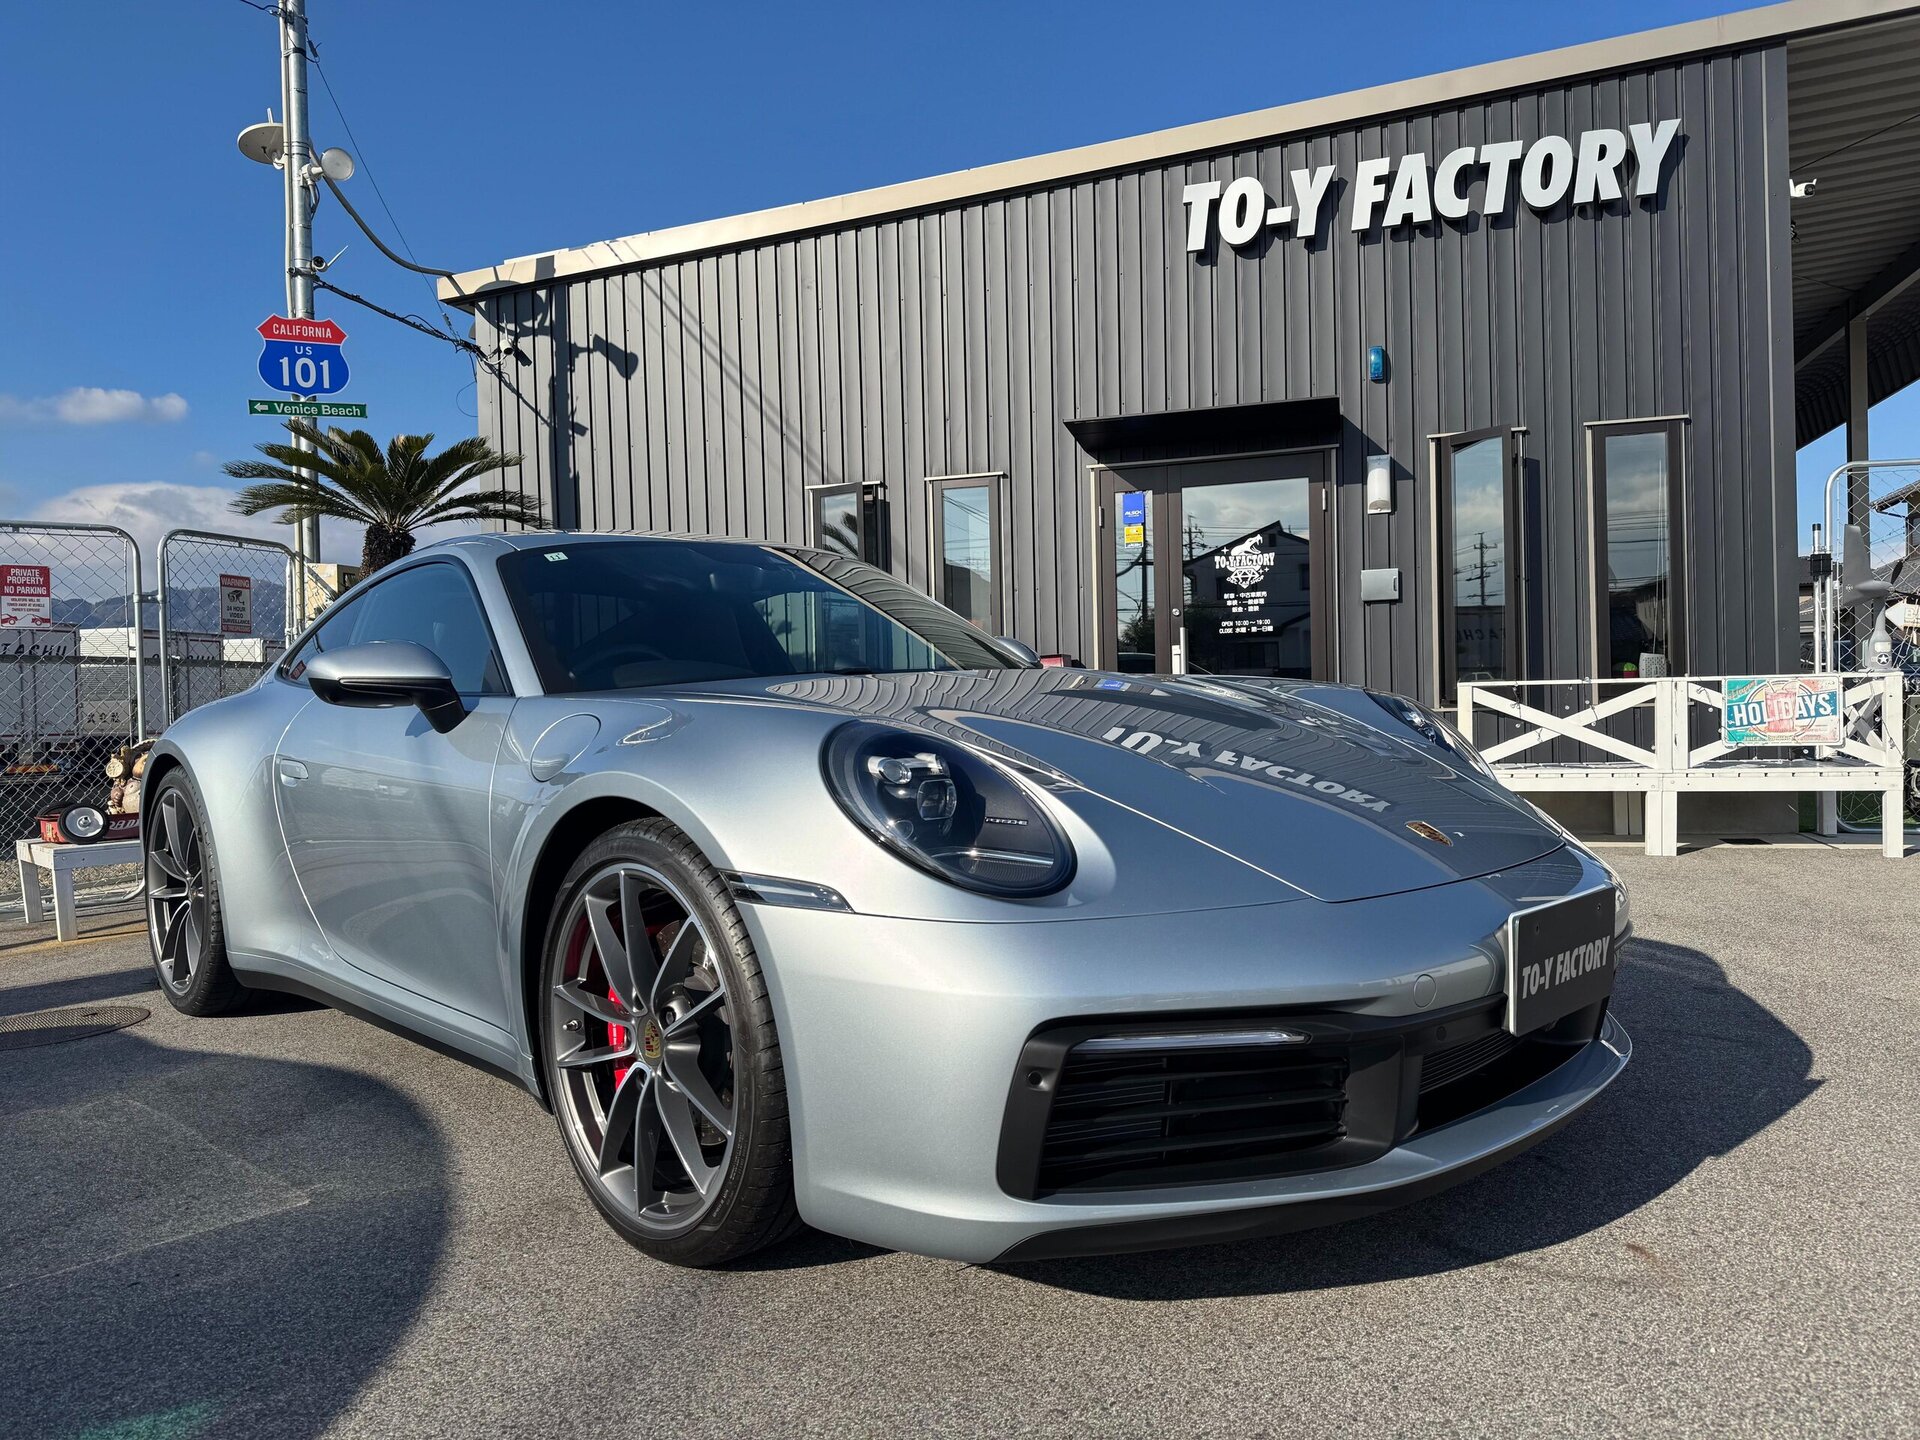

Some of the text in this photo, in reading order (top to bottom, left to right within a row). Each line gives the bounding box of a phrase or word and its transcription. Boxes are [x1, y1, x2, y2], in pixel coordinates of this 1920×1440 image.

[1183, 118, 1682, 253] TO-Y FACTORY
[272, 323, 332, 339] CALIFORNIA
[294, 345, 313, 355] US
[279, 356, 330, 389] 101
[274, 402, 361, 416] Venice Beach
[1214, 552, 1275, 569] TO-Y FACTORY
[10, 568, 40, 576] PRIVATE
[6, 575, 44, 585] PROPERTY
[221, 576, 250, 587] WARNING
[4, 585, 47, 595] NO PARKING
[1733, 692, 1832, 726] HOLIDAYS
[1522, 935, 1611, 999] TO-Y FACTORY
